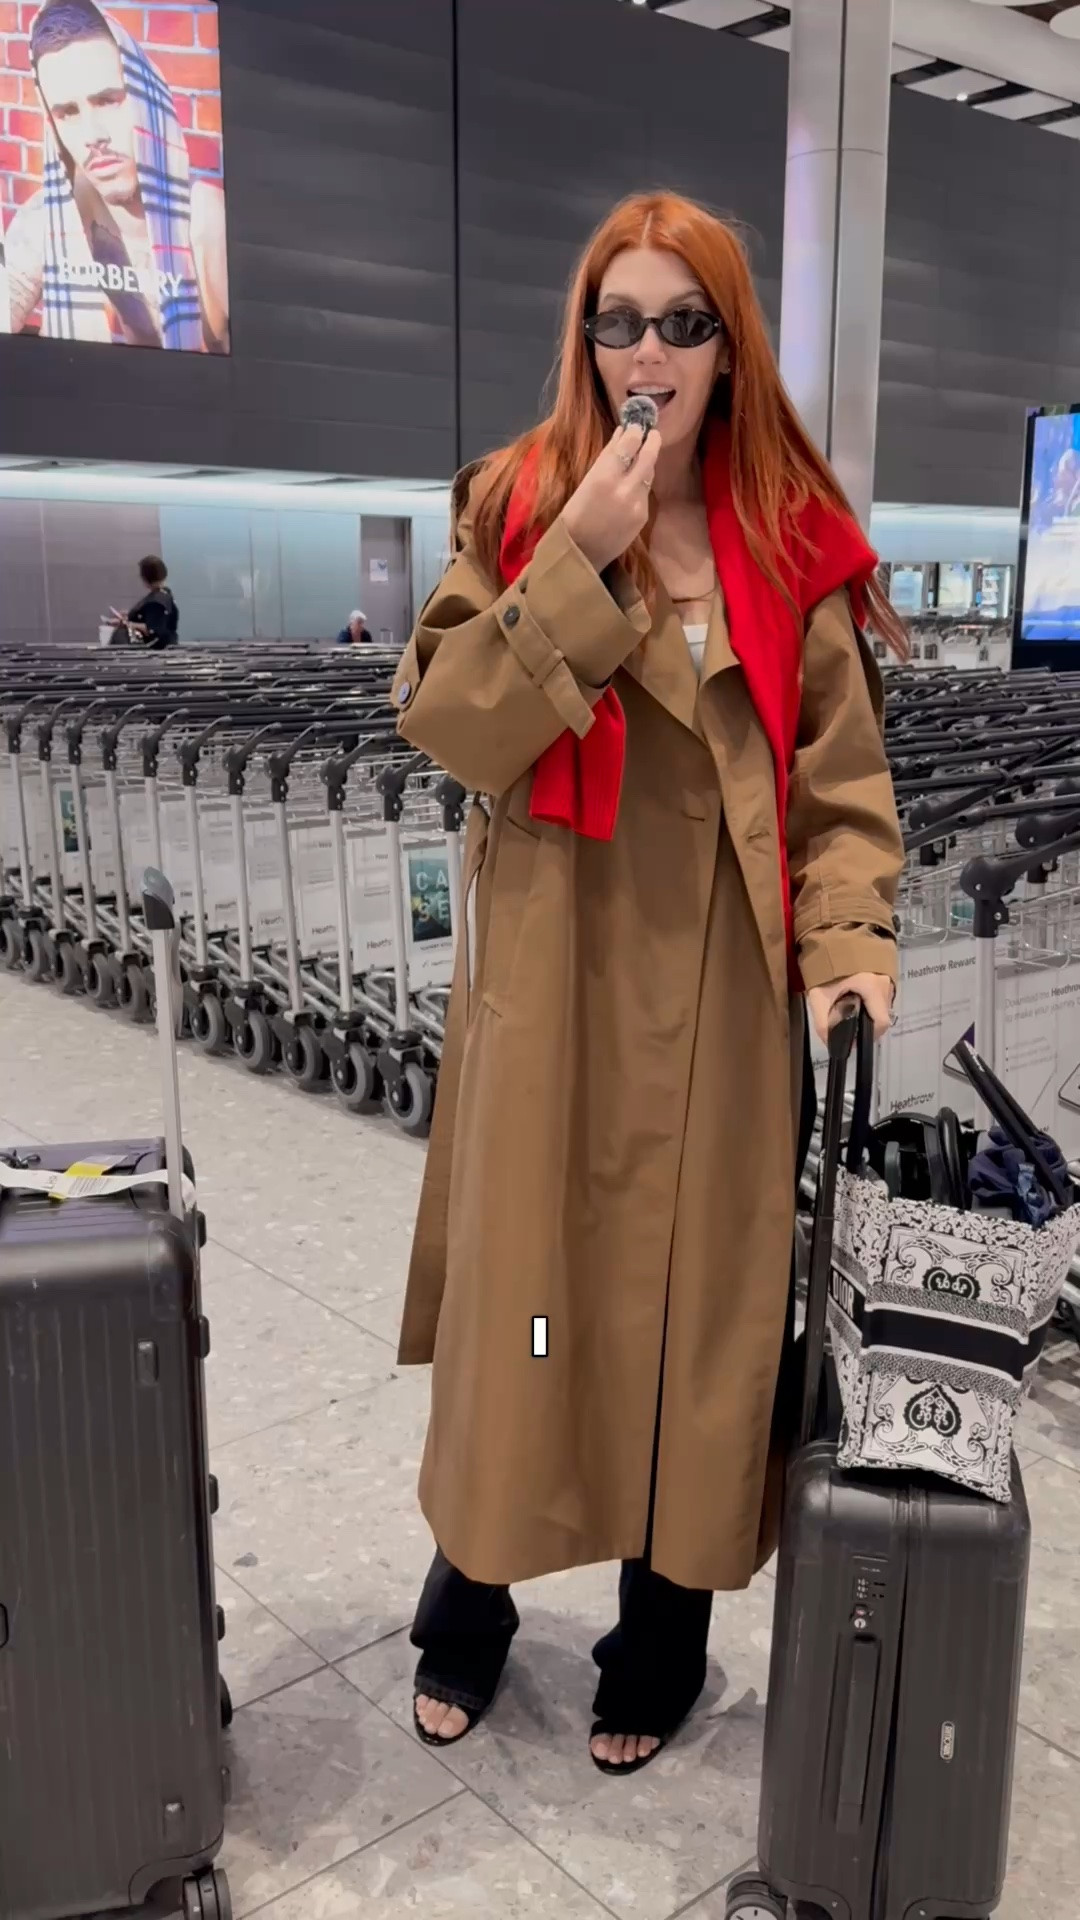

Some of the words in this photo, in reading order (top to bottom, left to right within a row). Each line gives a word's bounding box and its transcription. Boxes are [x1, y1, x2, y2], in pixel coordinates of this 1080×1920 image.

[59, 259, 182, 298] BURBERY
[907, 965, 947, 979] Heathrow
[890, 1091, 934, 1112] Heathrow
[832, 1269, 855, 1319] DIOR
